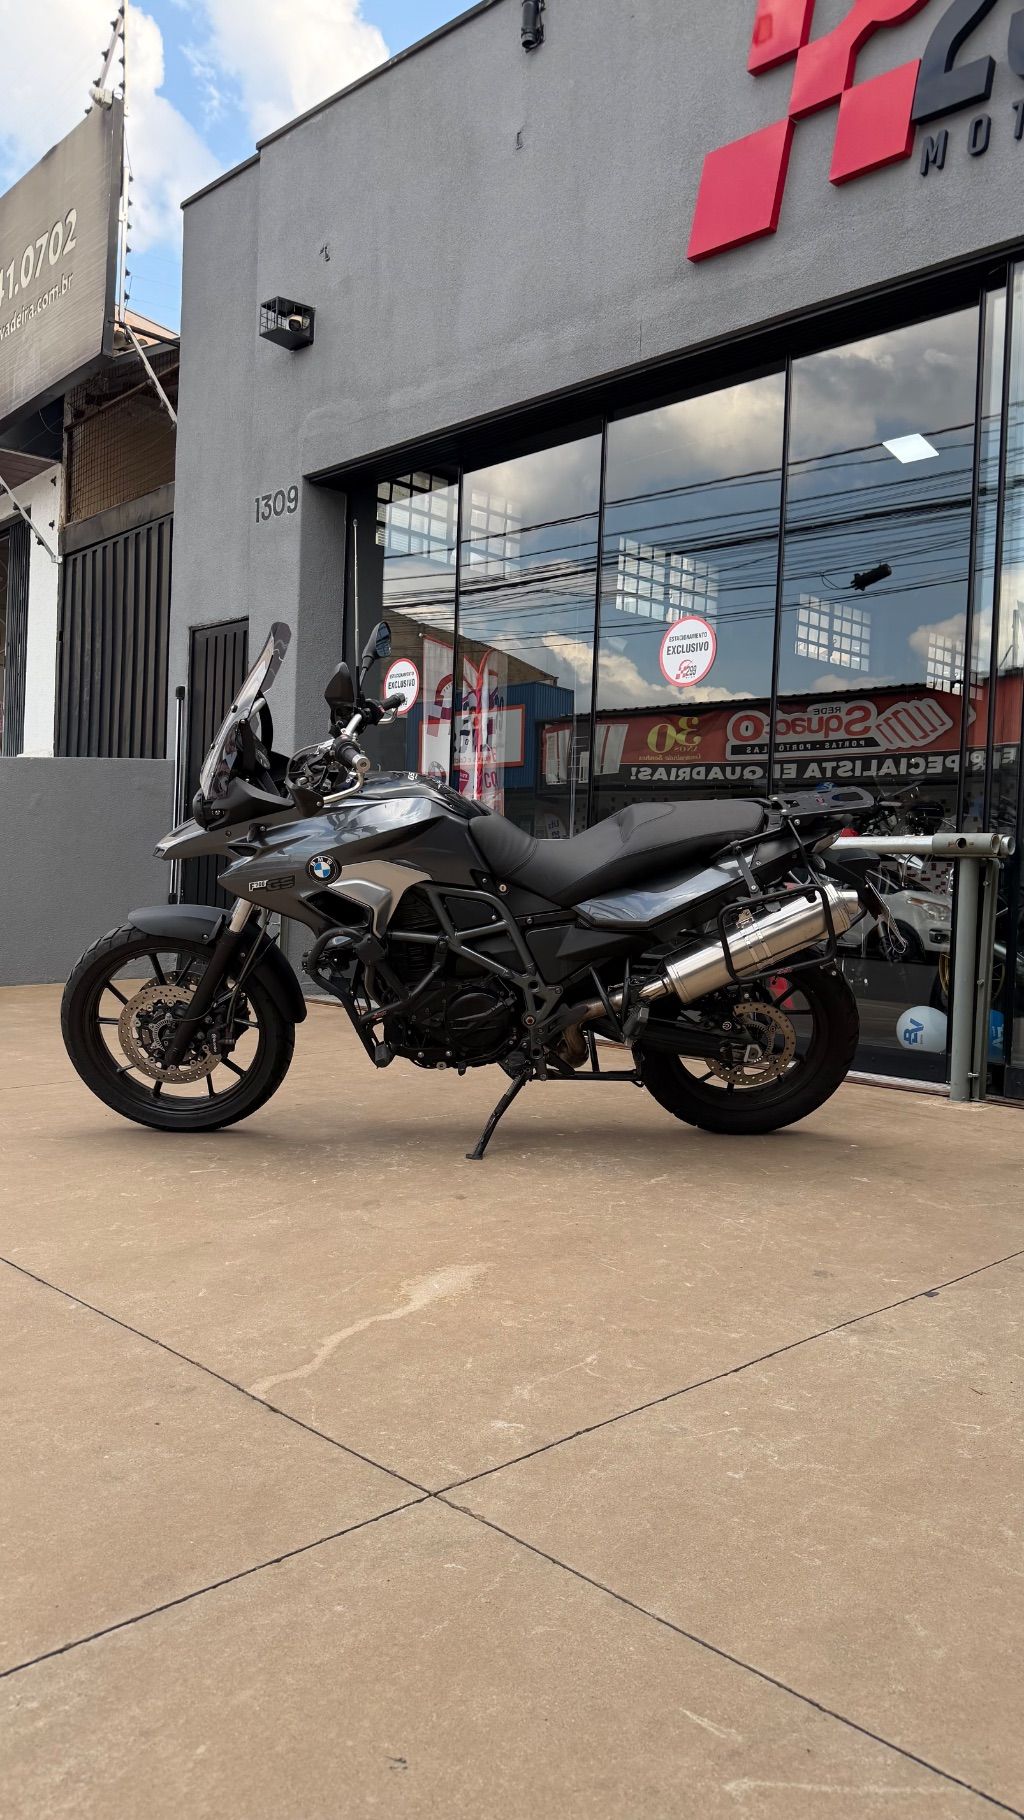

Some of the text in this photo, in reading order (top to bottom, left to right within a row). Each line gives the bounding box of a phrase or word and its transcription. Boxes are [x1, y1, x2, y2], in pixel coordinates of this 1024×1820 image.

[255, 485, 299, 523] 1309
[666, 641, 709, 656] EXCLUSIVO
[388, 678, 416, 690] EXCLUSIVO
